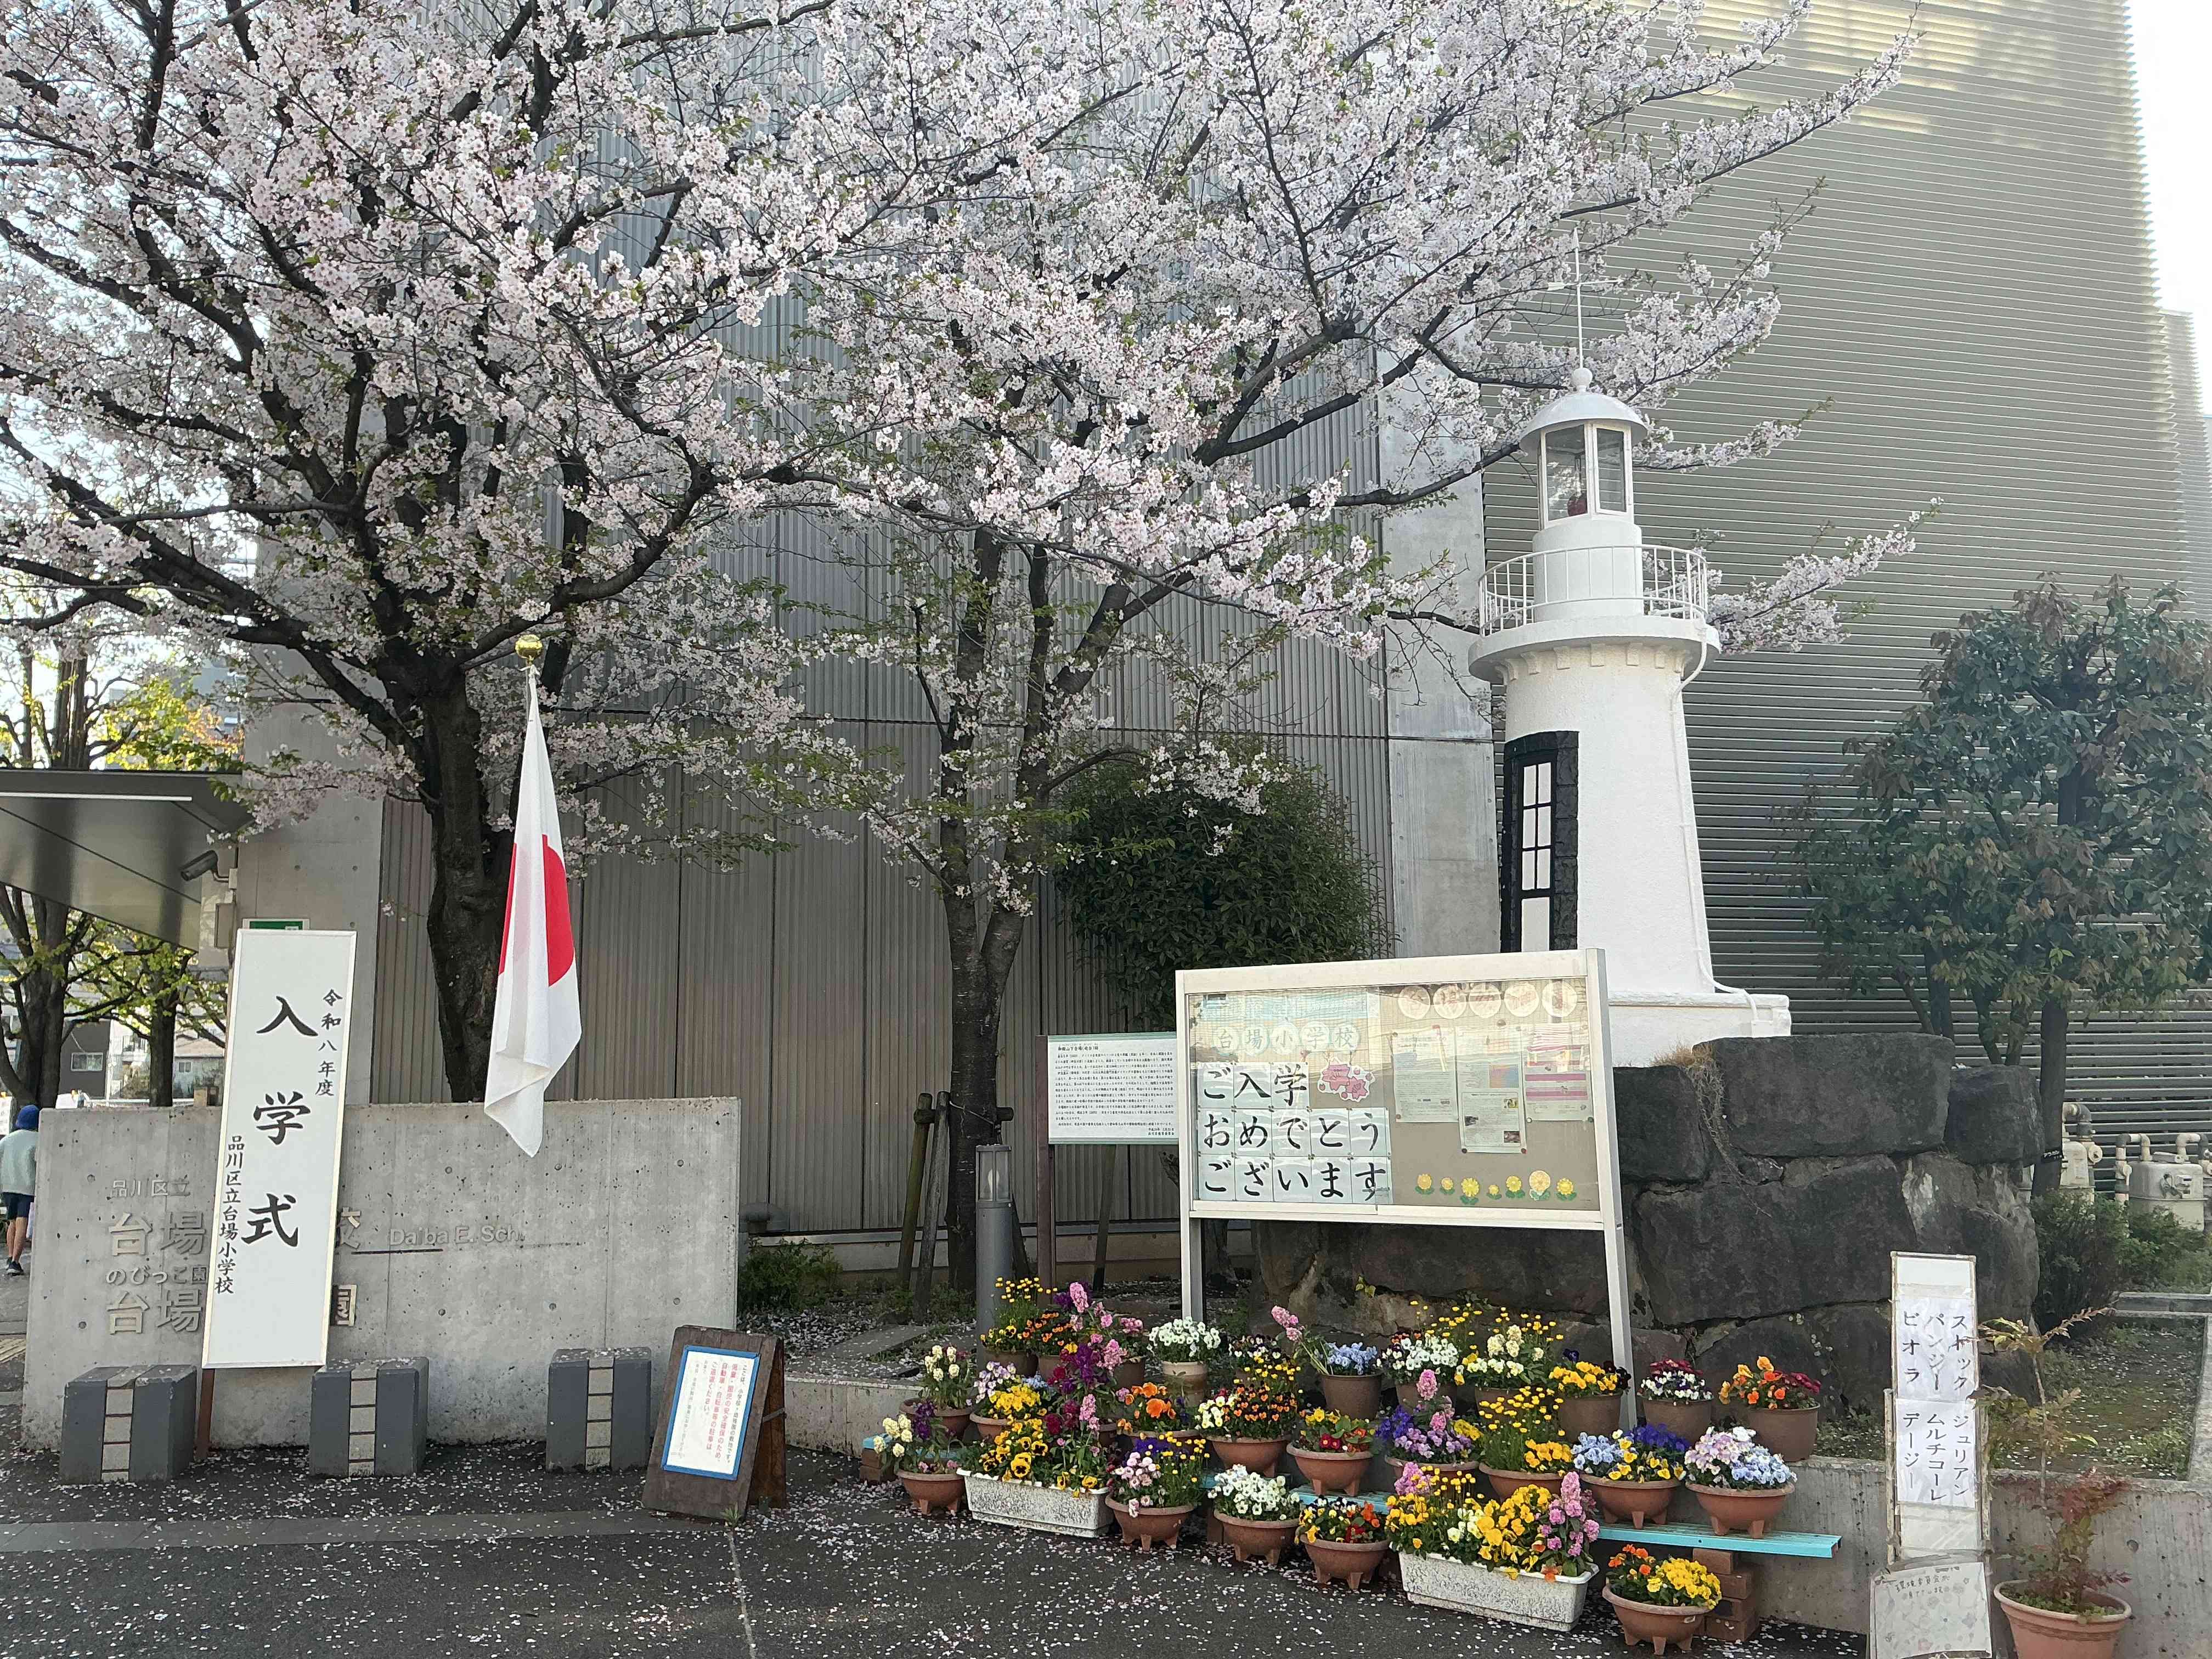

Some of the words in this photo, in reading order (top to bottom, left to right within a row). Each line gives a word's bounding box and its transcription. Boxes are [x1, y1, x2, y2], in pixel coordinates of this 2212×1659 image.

[315, 989, 343, 1096] 令和八年度
[1217, 1026, 1355, 1049] 台場小学校
[241, 995, 318, 1247] 入学式
[1204, 1064, 1307, 1106] ご入学
[1204, 1113, 1378, 1151] おめでとう
[110, 1179, 191, 1198] 品川区立
[215, 1135, 245, 1294] 品川区立台場小学校
[1205, 1159, 1386, 1201] ございます
[390, 1227, 449, 1246] Daiba
[455, 1225, 474, 1244] E.
[105, 1264, 207, 1285] のびっこ園
[1903, 1311, 1920, 1384] ビオラ
[1924, 1313, 1945, 1390] パンジー
[1951, 1316, 1971, 1391] ストック
[1903, 1413, 1920, 1489] デージー
[1926, 1413, 1946, 1500] ムルチコーレ
[1953, 1415, 1971, 1496] ジュリアン
